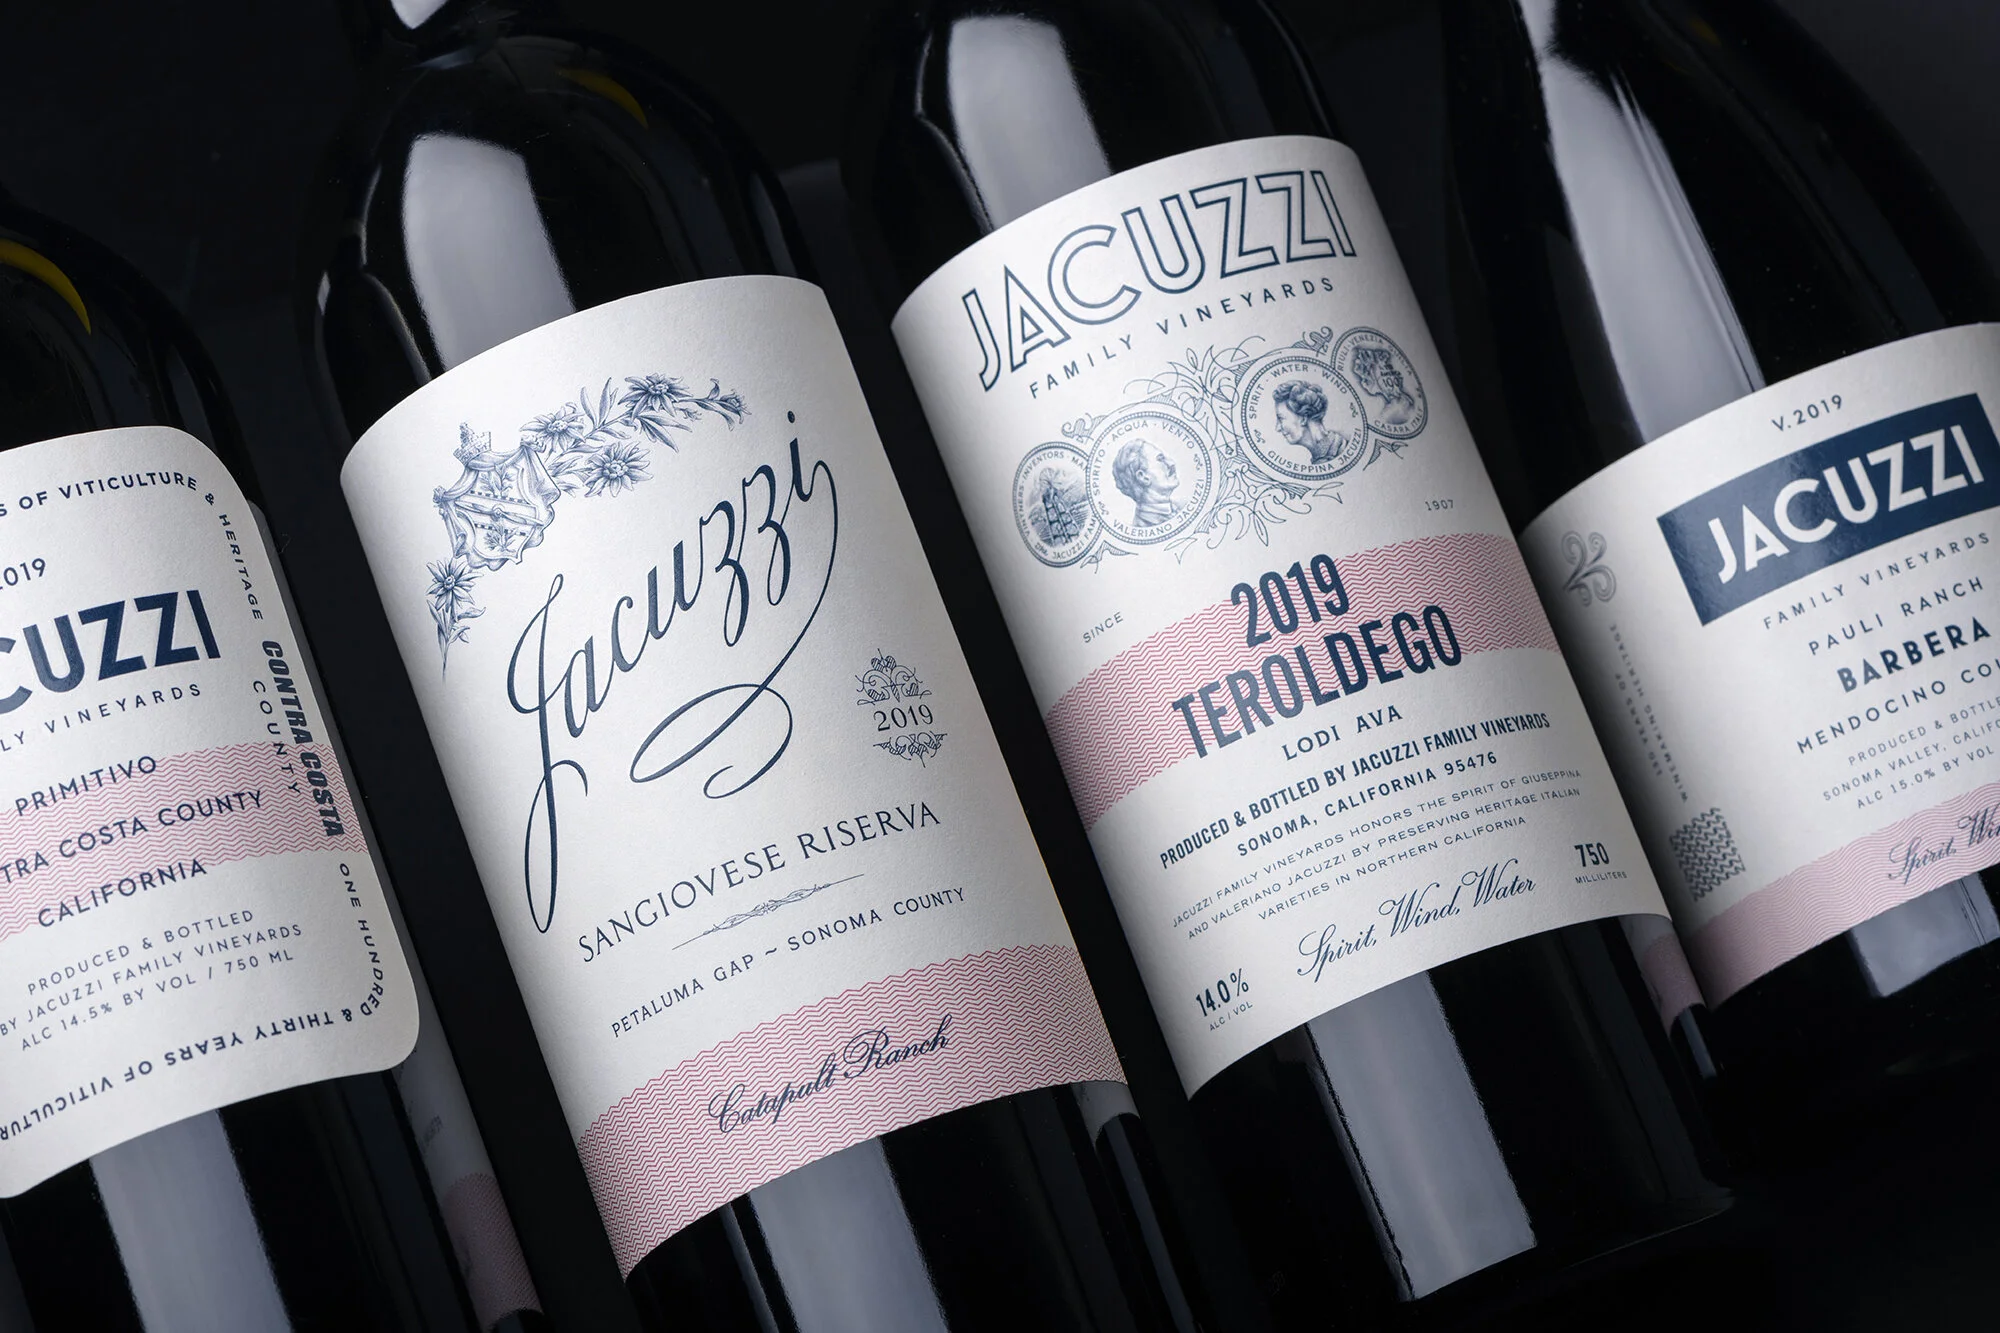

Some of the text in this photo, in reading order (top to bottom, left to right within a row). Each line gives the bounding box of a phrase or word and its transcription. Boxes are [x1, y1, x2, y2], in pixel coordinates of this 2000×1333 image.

[961, 169, 1358, 392] JACUZZI
[1028, 276, 1334, 400] FAMILY VINEYARDS
[1249, 363, 1347, 419] SPIRIT WATER WIND
[1771, 394, 1843, 431] V.2019
[1022, 450, 1064, 480] INVENTORS
[1092, 420, 1195, 496] SPIRITO ACQUA VENTO
[1267, 428, 1362, 473] GIUSEPPINA JACUZZI
[1113, 478, 1205, 538] VALERIANO JACUZZI
[1424, 499, 1454, 511] 1907
[1707, 424, 1985, 584] JACUZZI
[0, 558, 46, 590] 019
[19, 491, 47, 509] OF
[58, 471, 197, 499] VITICULTURE
[218, 514, 264, 620] HERITAGE
[1052, 541, 1085, 560] JACUZZI
[1763, 532, 1990, 630] FAMILY VINEYARDS
[1082, 611, 1124, 643] SINCE
[1230, 553, 1350, 649] 2019
[1808, 577, 1984, 656] PAULI RANCH
[507, 410, 838, 933] Jacuzzi
[1172, 604, 1463, 759] TEROLDEGO
[1837, 616, 1992, 693] BARBERA
[44, 684, 201, 734] VINEYARDS
[253, 680, 300, 793] COUNTY
[262, 640, 345, 837] CONTRA COSTA
[873, 704, 933, 732] 2019
[1281, 705, 1403, 761] LODI AVA
[1796, 658, 2000, 754] MENDOCINO CO
[1848, 726, 1927, 766] PRODUCED
[1934, 719, 1943, 730] &
[15, 756, 157, 817] PRIMITIVO
[1160, 712, 1550, 870] PRODUCED & BOTTLED BY JACUZZI FAMILY VINEYARDS
[1237, 751, 1497, 857] SONOMA, CALIFORNIA 95476
[1822, 768, 1883, 801] SONOMA
[1856, 745, 1995, 809] ALC 15.0% BY VOL
[58, 816, 148, 858] COSTA
[157, 790, 262, 826] COUNTY
[1172, 769, 1581, 928] JACUZZI FAMILY VINEYARDS HONORS THE SPIRIT OF GIUSEPPINA
[1574, 842, 1610, 868] 750
[38, 858, 208, 927] CALIFORNIA
[339, 863, 362, 908] ONE
[577, 801, 941, 963] SANGIOVESE RISERVA
[1188, 787, 1581, 940] AND VALERIANO JACUZZI BY PRESERVING HERITAGE ITALIAN
[1258, 815, 1527, 920] VARIETIES IN NORTHERN CALIFORNIA
[1575, 871, 1628, 885] MILLILITERS
[27, 910, 253, 995] PRODUCED & BOTTLED
[1296, 858, 1537, 983] Spirit, Wind, Water
[0, 923, 302, 1036] BY JACUZZI FAMILY VINEYARDS
[21, 1026, 53, 1052] ALC
[60, 1002, 113, 1031] 14.5%
[122, 988, 144, 1006] BY
[156, 973, 197, 993] VOL
[223, 955, 259, 974] 750
[269, 949, 294, 964] ML
[358, 919, 384, 1017] HUNDRED
[610, 978, 705, 1038] PETALUMA
[712, 953, 756, 983] GAP
[787, 908, 883, 952] SONOMA
[893, 887, 965, 917] COUNTY
[1196, 968, 1250, 1017] 14.0%
[164, 1031, 244, 1067] YEARS
[255, 1011, 334, 1040] THIRTY
[1209, 1016, 1226, 1032] ALC
[1232, 1001, 1254, 1016] VOL
[124, 1060, 153, 1083] OF
[708, 1014, 953, 1134] Catapult Ranch
